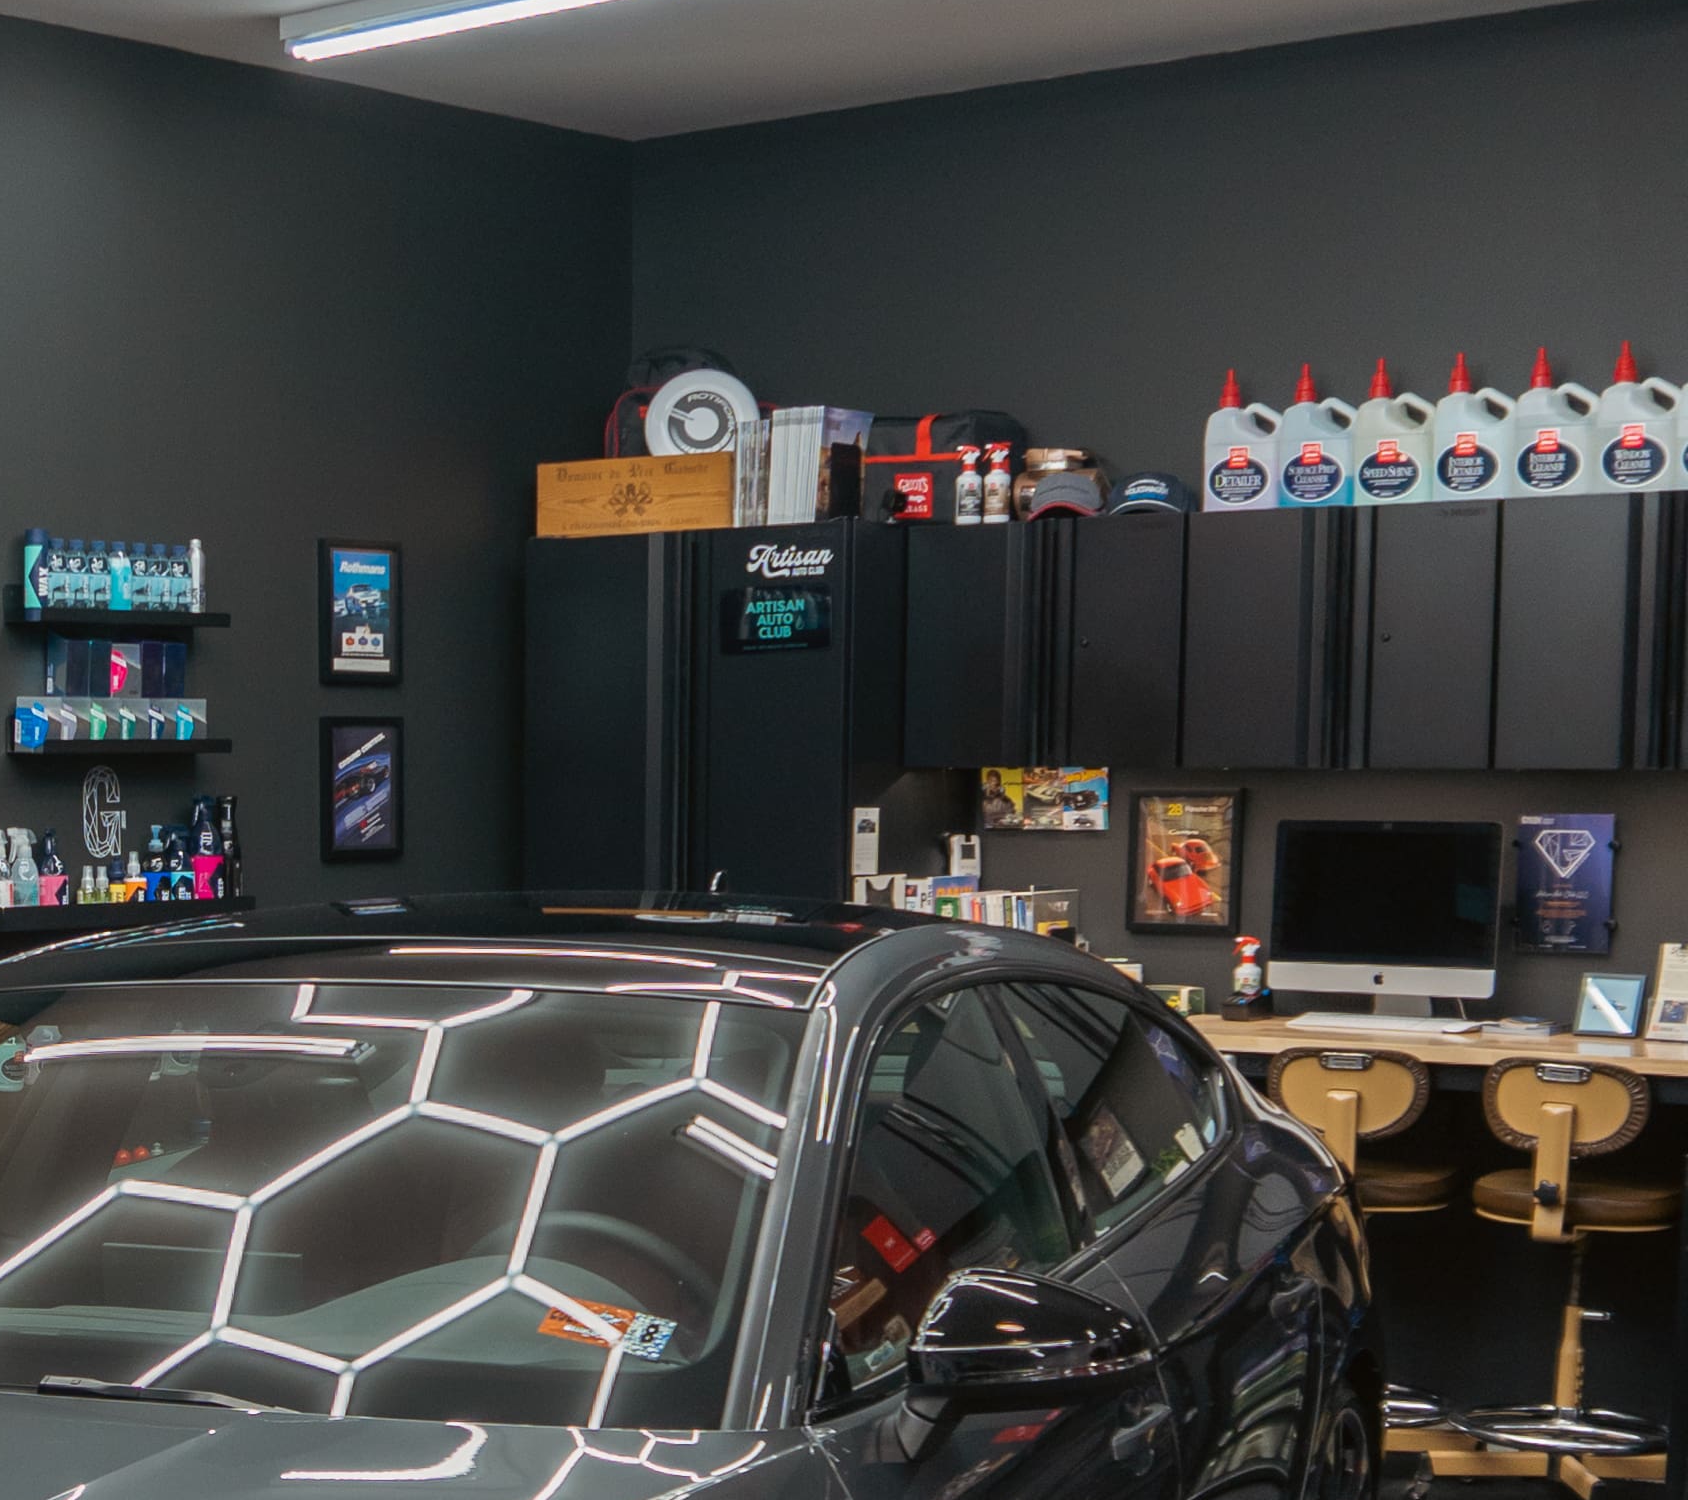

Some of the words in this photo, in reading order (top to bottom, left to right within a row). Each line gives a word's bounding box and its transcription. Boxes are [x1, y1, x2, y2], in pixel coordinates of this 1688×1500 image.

[746, 544, 834, 578] Artisan
[38, 567, 50, 597] WAX
[745, 599, 805, 614] ARTISAN
[757, 613, 793, 626] AUTO
[759, 625, 792, 639] CLUB
